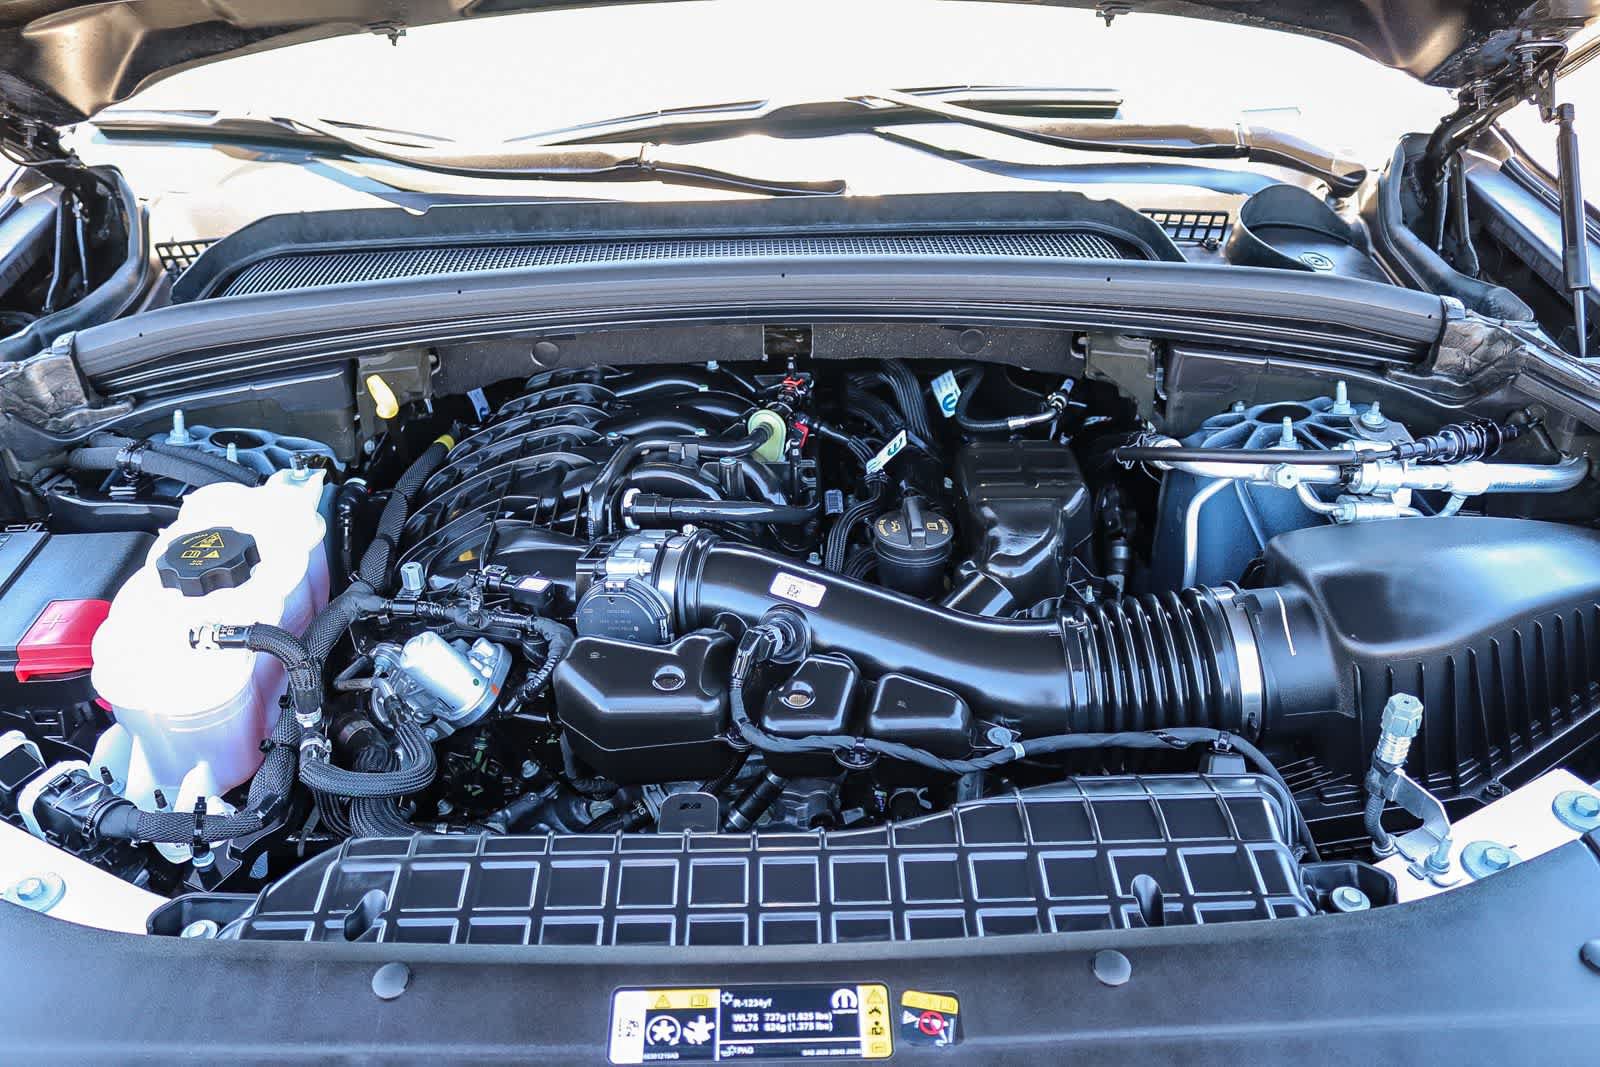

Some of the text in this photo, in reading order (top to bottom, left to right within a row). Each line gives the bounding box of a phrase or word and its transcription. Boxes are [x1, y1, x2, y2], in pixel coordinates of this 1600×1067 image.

[732, 998, 773, 1008] R-1234yf
[732, 1012, 759, 1022] WL75
[763, 1013, 787, 1023] 737g
